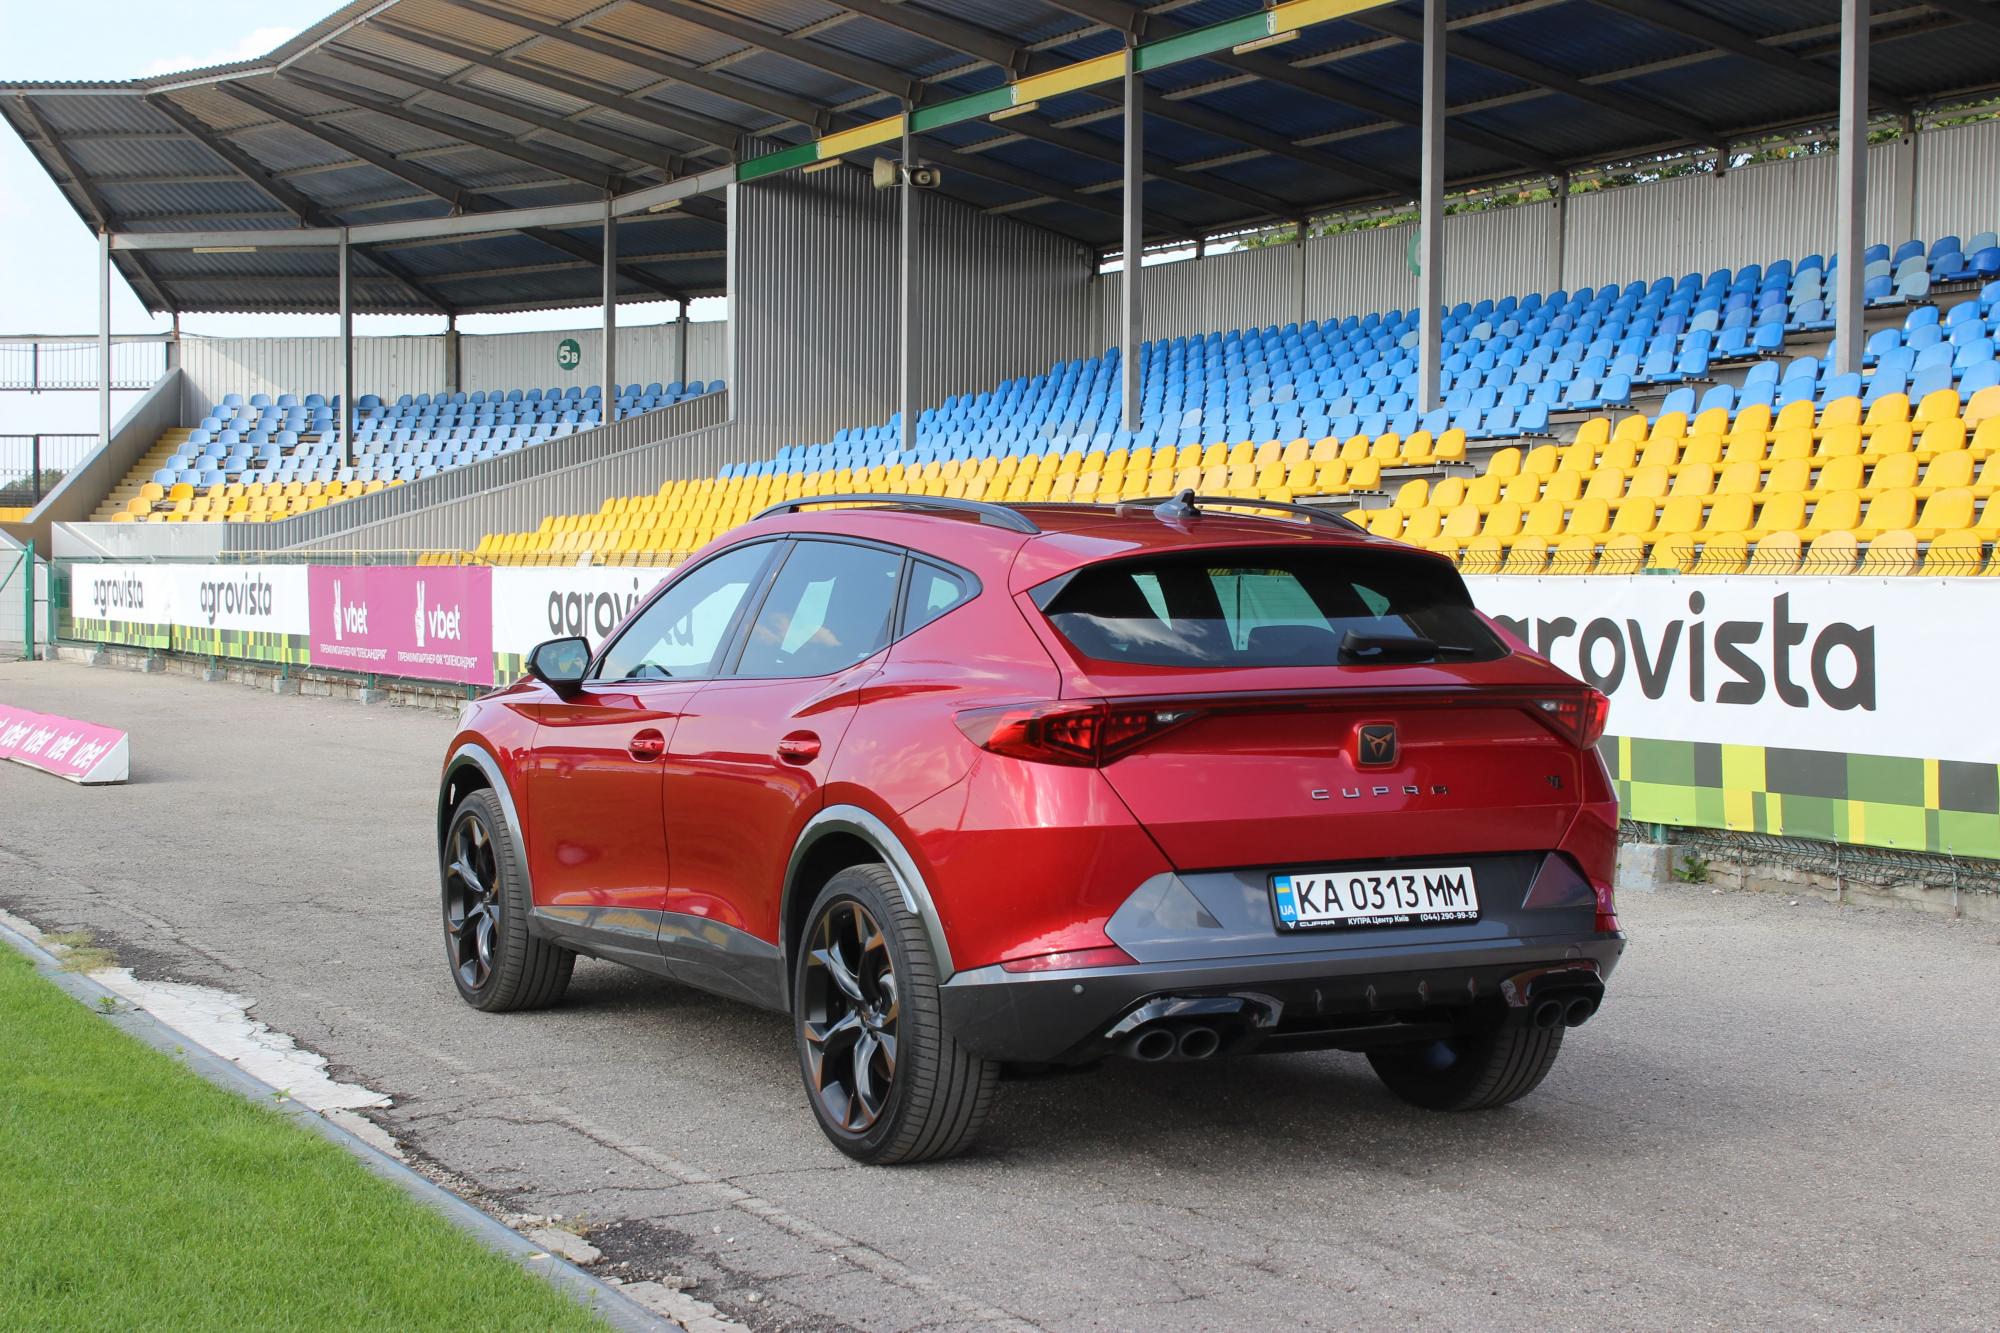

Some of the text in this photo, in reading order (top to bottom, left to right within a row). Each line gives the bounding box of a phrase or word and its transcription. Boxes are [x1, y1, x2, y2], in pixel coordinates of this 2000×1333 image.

[93, 570, 144, 617] agrovista
[200, 571, 273, 625] agrovista
[343, 600, 368, 635] vbet
[428, 603, 461, 641] vbet
[1280, 905, 1295, 916] UA
[1296, 873, 1469, 914] KA 0313 MM
[1347, 914, 1410, 926] КУПРА Центр Київ
[1420, 911, 1478, 922] (044) 290-99-50
